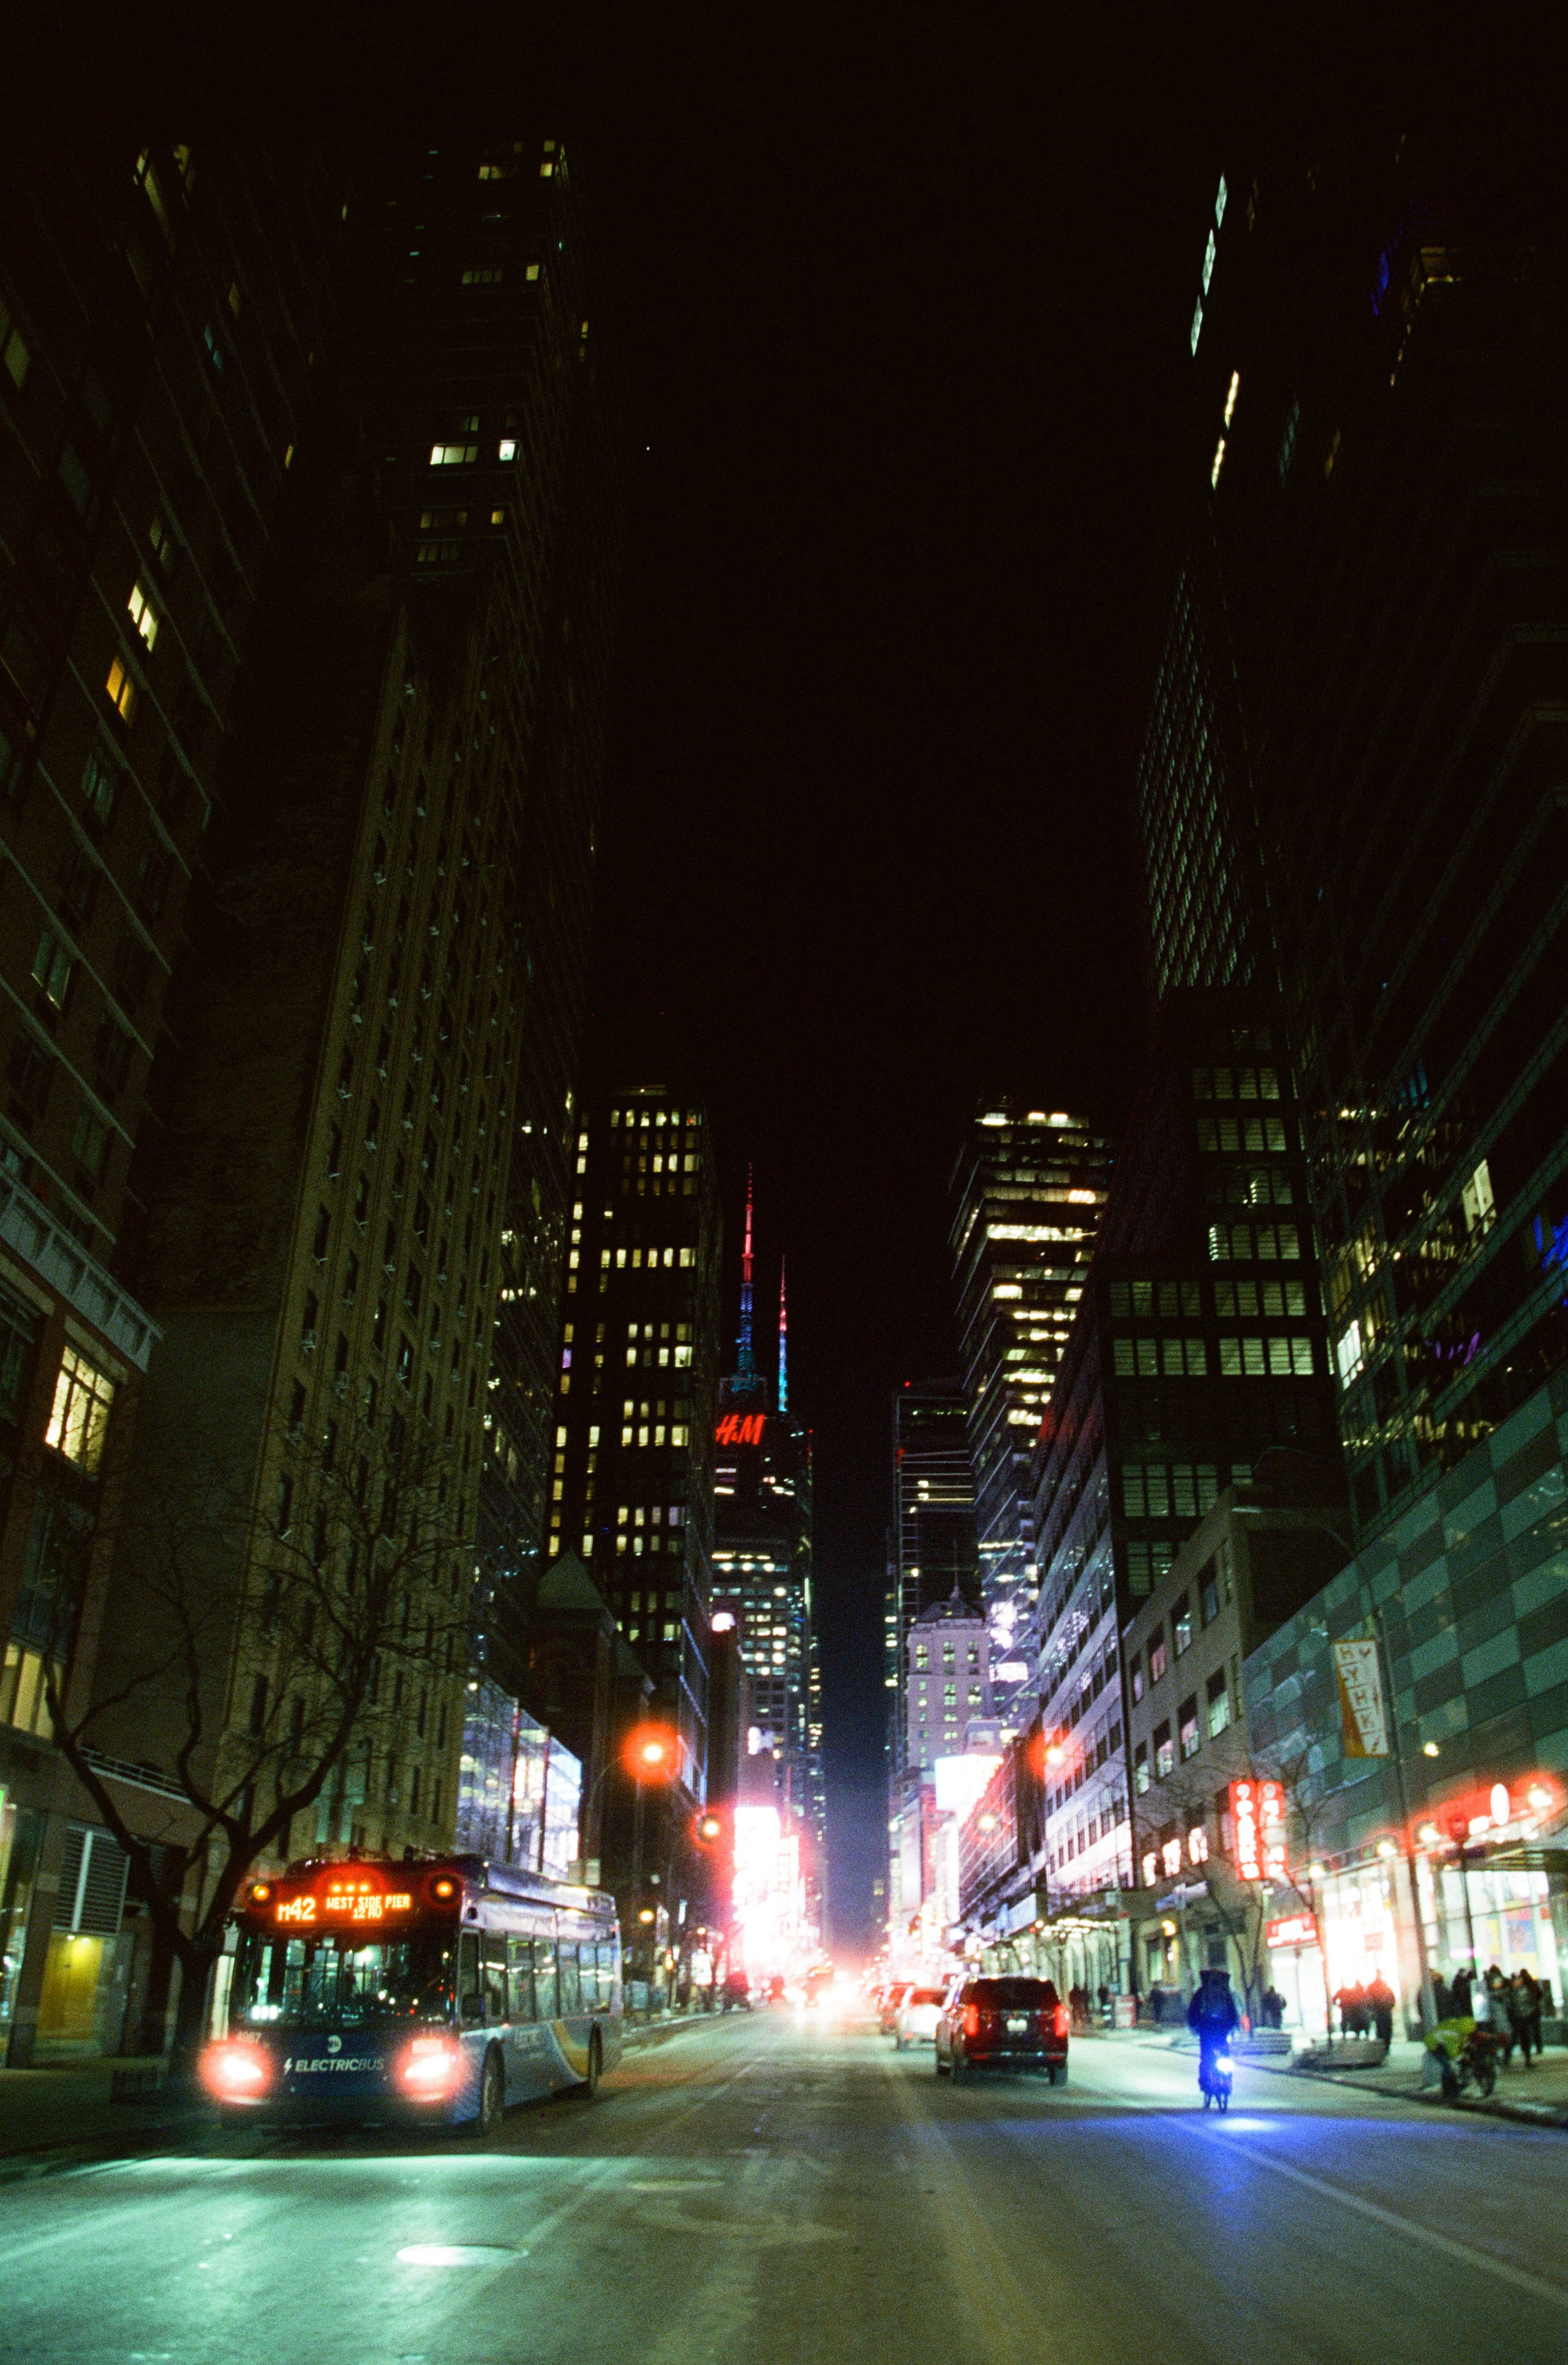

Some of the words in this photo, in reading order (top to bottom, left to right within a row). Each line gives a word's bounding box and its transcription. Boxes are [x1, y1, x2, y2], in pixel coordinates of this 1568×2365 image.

[715, 1414, 765, 1446] H&M
[278, 1897, 315, 1921] M42
[326, 1896, 354, 1910] WEST
[358, 1896, 382, 1909] SIDE
[385, 1895, 410, 1909] PIER
